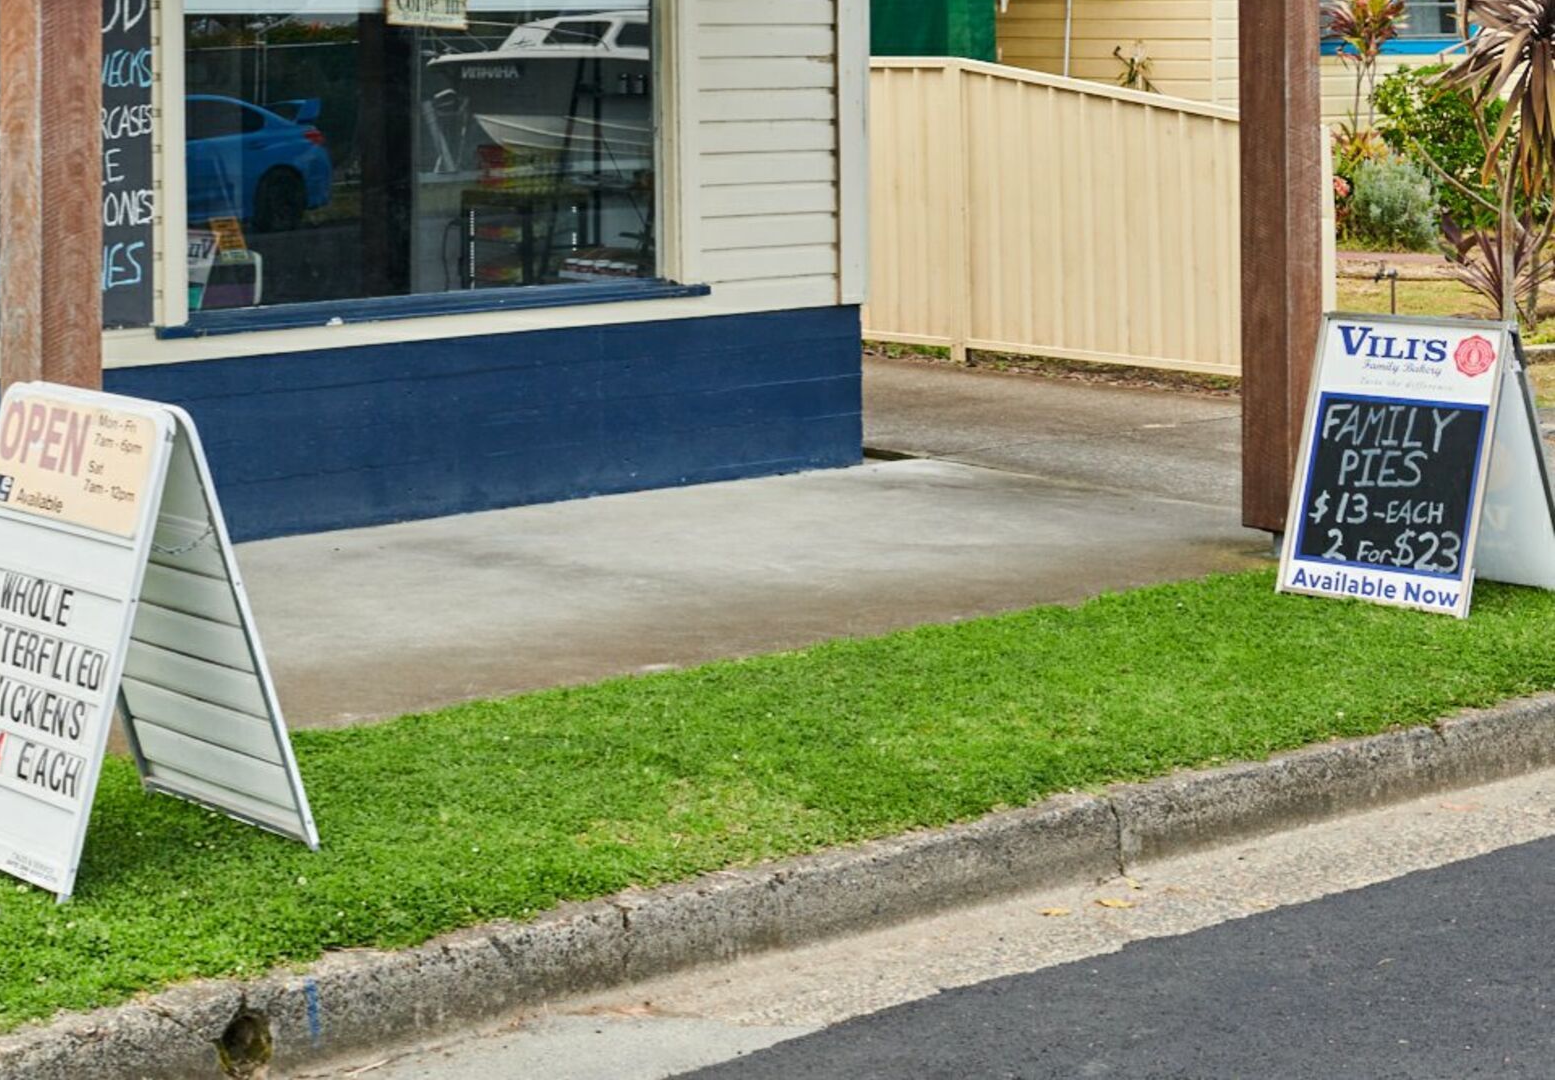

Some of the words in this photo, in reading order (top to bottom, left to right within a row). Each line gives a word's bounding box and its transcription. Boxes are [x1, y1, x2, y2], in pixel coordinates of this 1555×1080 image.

[1362, 359, 1400, 374] Family
[1403, 362, 1442, 377] Bakery
[0, 400, 92, 477] OPEN
[1321, 403, 1460, 454] FAMILY
[88, 460, 104, 475] Sat
[1338, 448, 1428, 487] PIES
[16, 488, 63, 513] Available
[1322, 527, 1347, 561] 2
[1391, 528, 1462, 575] $23
[0, 572, 74, 627] WHOLE
[1291, 567, 1397, 599] Available
[1403, 582, 1460, 607] Now
[16, 741, 82, 797] EACH
